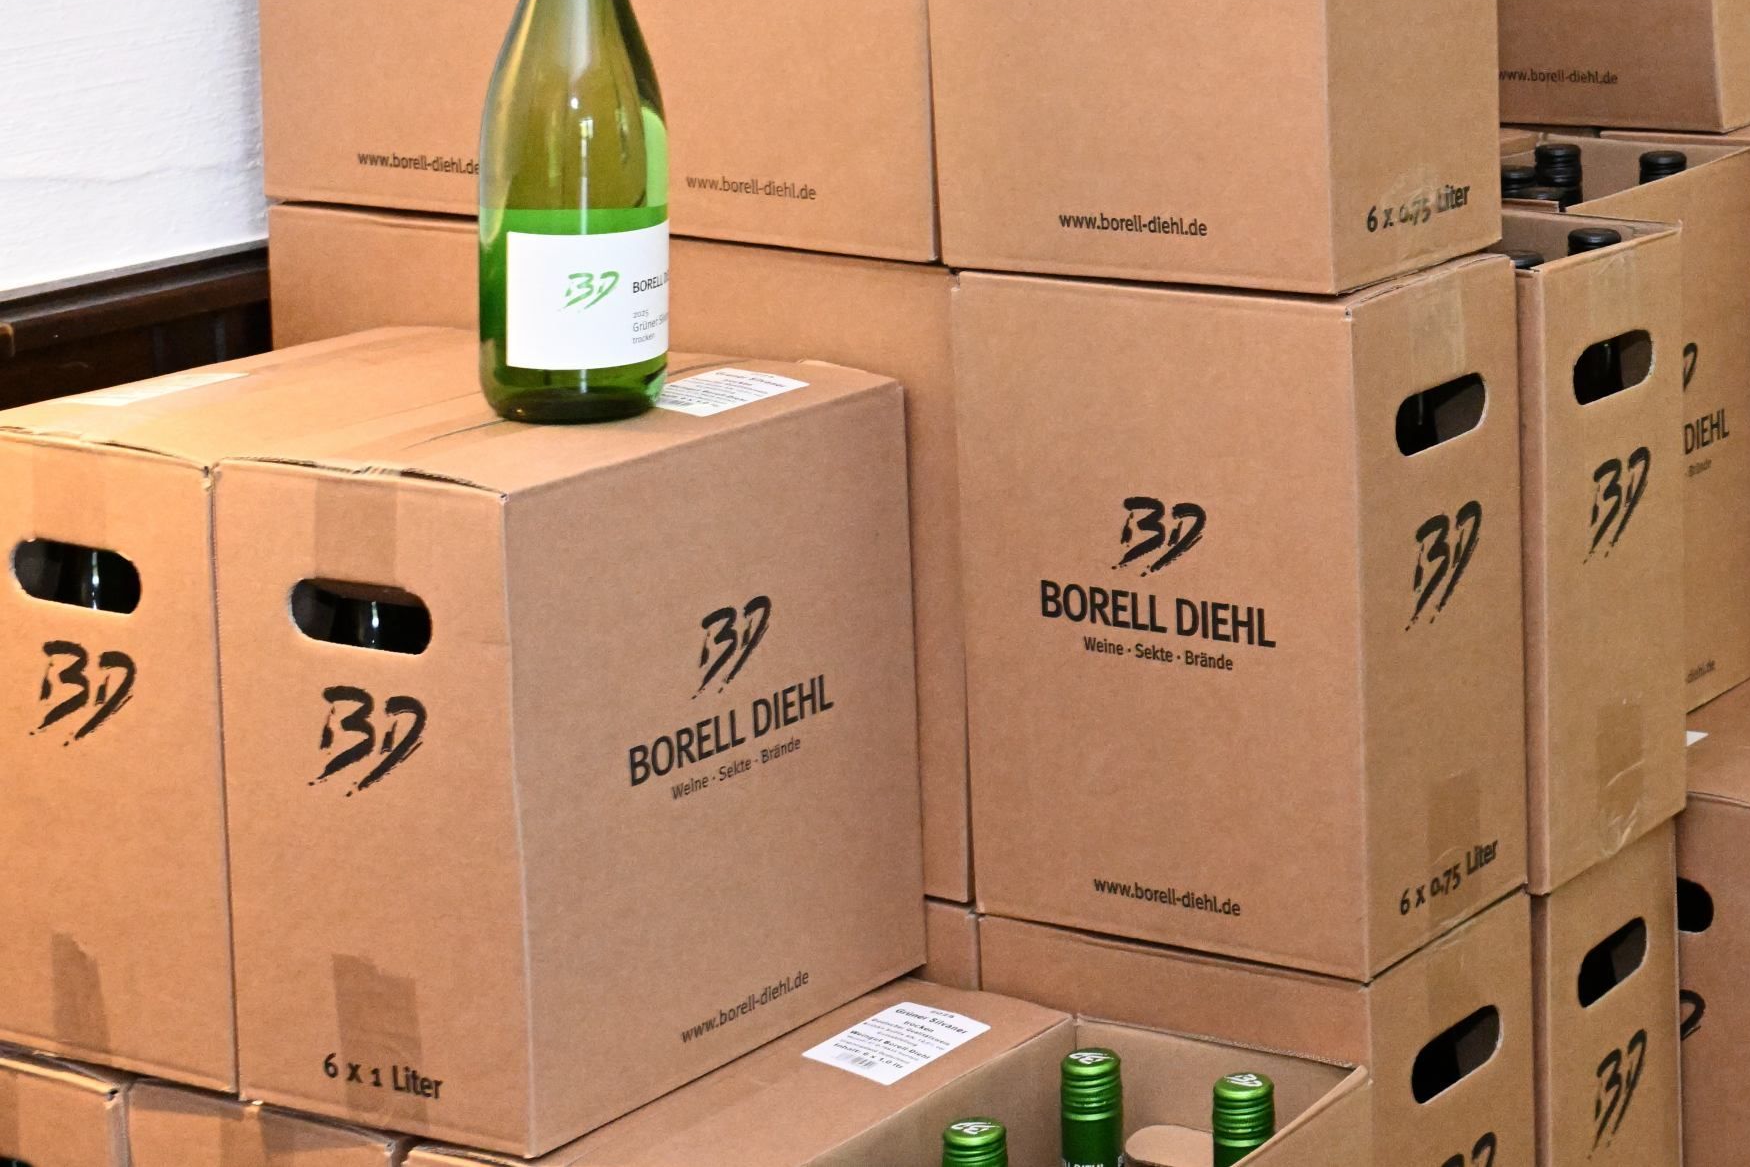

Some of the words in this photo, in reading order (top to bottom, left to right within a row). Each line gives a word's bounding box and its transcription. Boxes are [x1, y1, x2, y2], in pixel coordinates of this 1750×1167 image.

[686, 174, 817, 201] www.borell-diehl.de
[1366, 205, 1378, 233] 6
[1436, 183, 1471, 214] Liter
[1059, 213, 1208, 237] www.borell-diehl.de
[632, 274, 663, 293] BORELL
[632, 318, 659, 333] Grüner
[632, 332, 656, 345] trocken
[1684, 409, 1730, 455] DIEHL
[1040, 580, 1168, 635] BORELL
[1175, 597, 1277, 649] DIEHL
[1083, 636, 1124, 656] Weine
[1134, 643, 1174, 663] Sekte
[1184, 649, 1234, 671] Brände
[628, 710, 746, 787] BORELL
[752, 674, 835, 737] DIEHL
[671, 775, 709, 800] Weine
[718, 758, 752, 784] Sekte
[761, 736, 802, 767] Brände
[1093, 877, 1241, 917] www.borell-diehl.de
[1399, 890, 1411, 917] 6
[1414, 883, 1426, 909] x
[1465, 837, 1499, 874] Liter
[682, 969, 811, 1045] www.borell-diehl.de
[894, 1007, 930, 1025] Grüner
[928, 1017, 969, 1035] Silvaner
[323, 1052, 339, 1080] 6
[347, 1061, 363, 1085] x
[370, 1067, 383, 1089] 1
[392, 1064, 444, 1101] Liter
